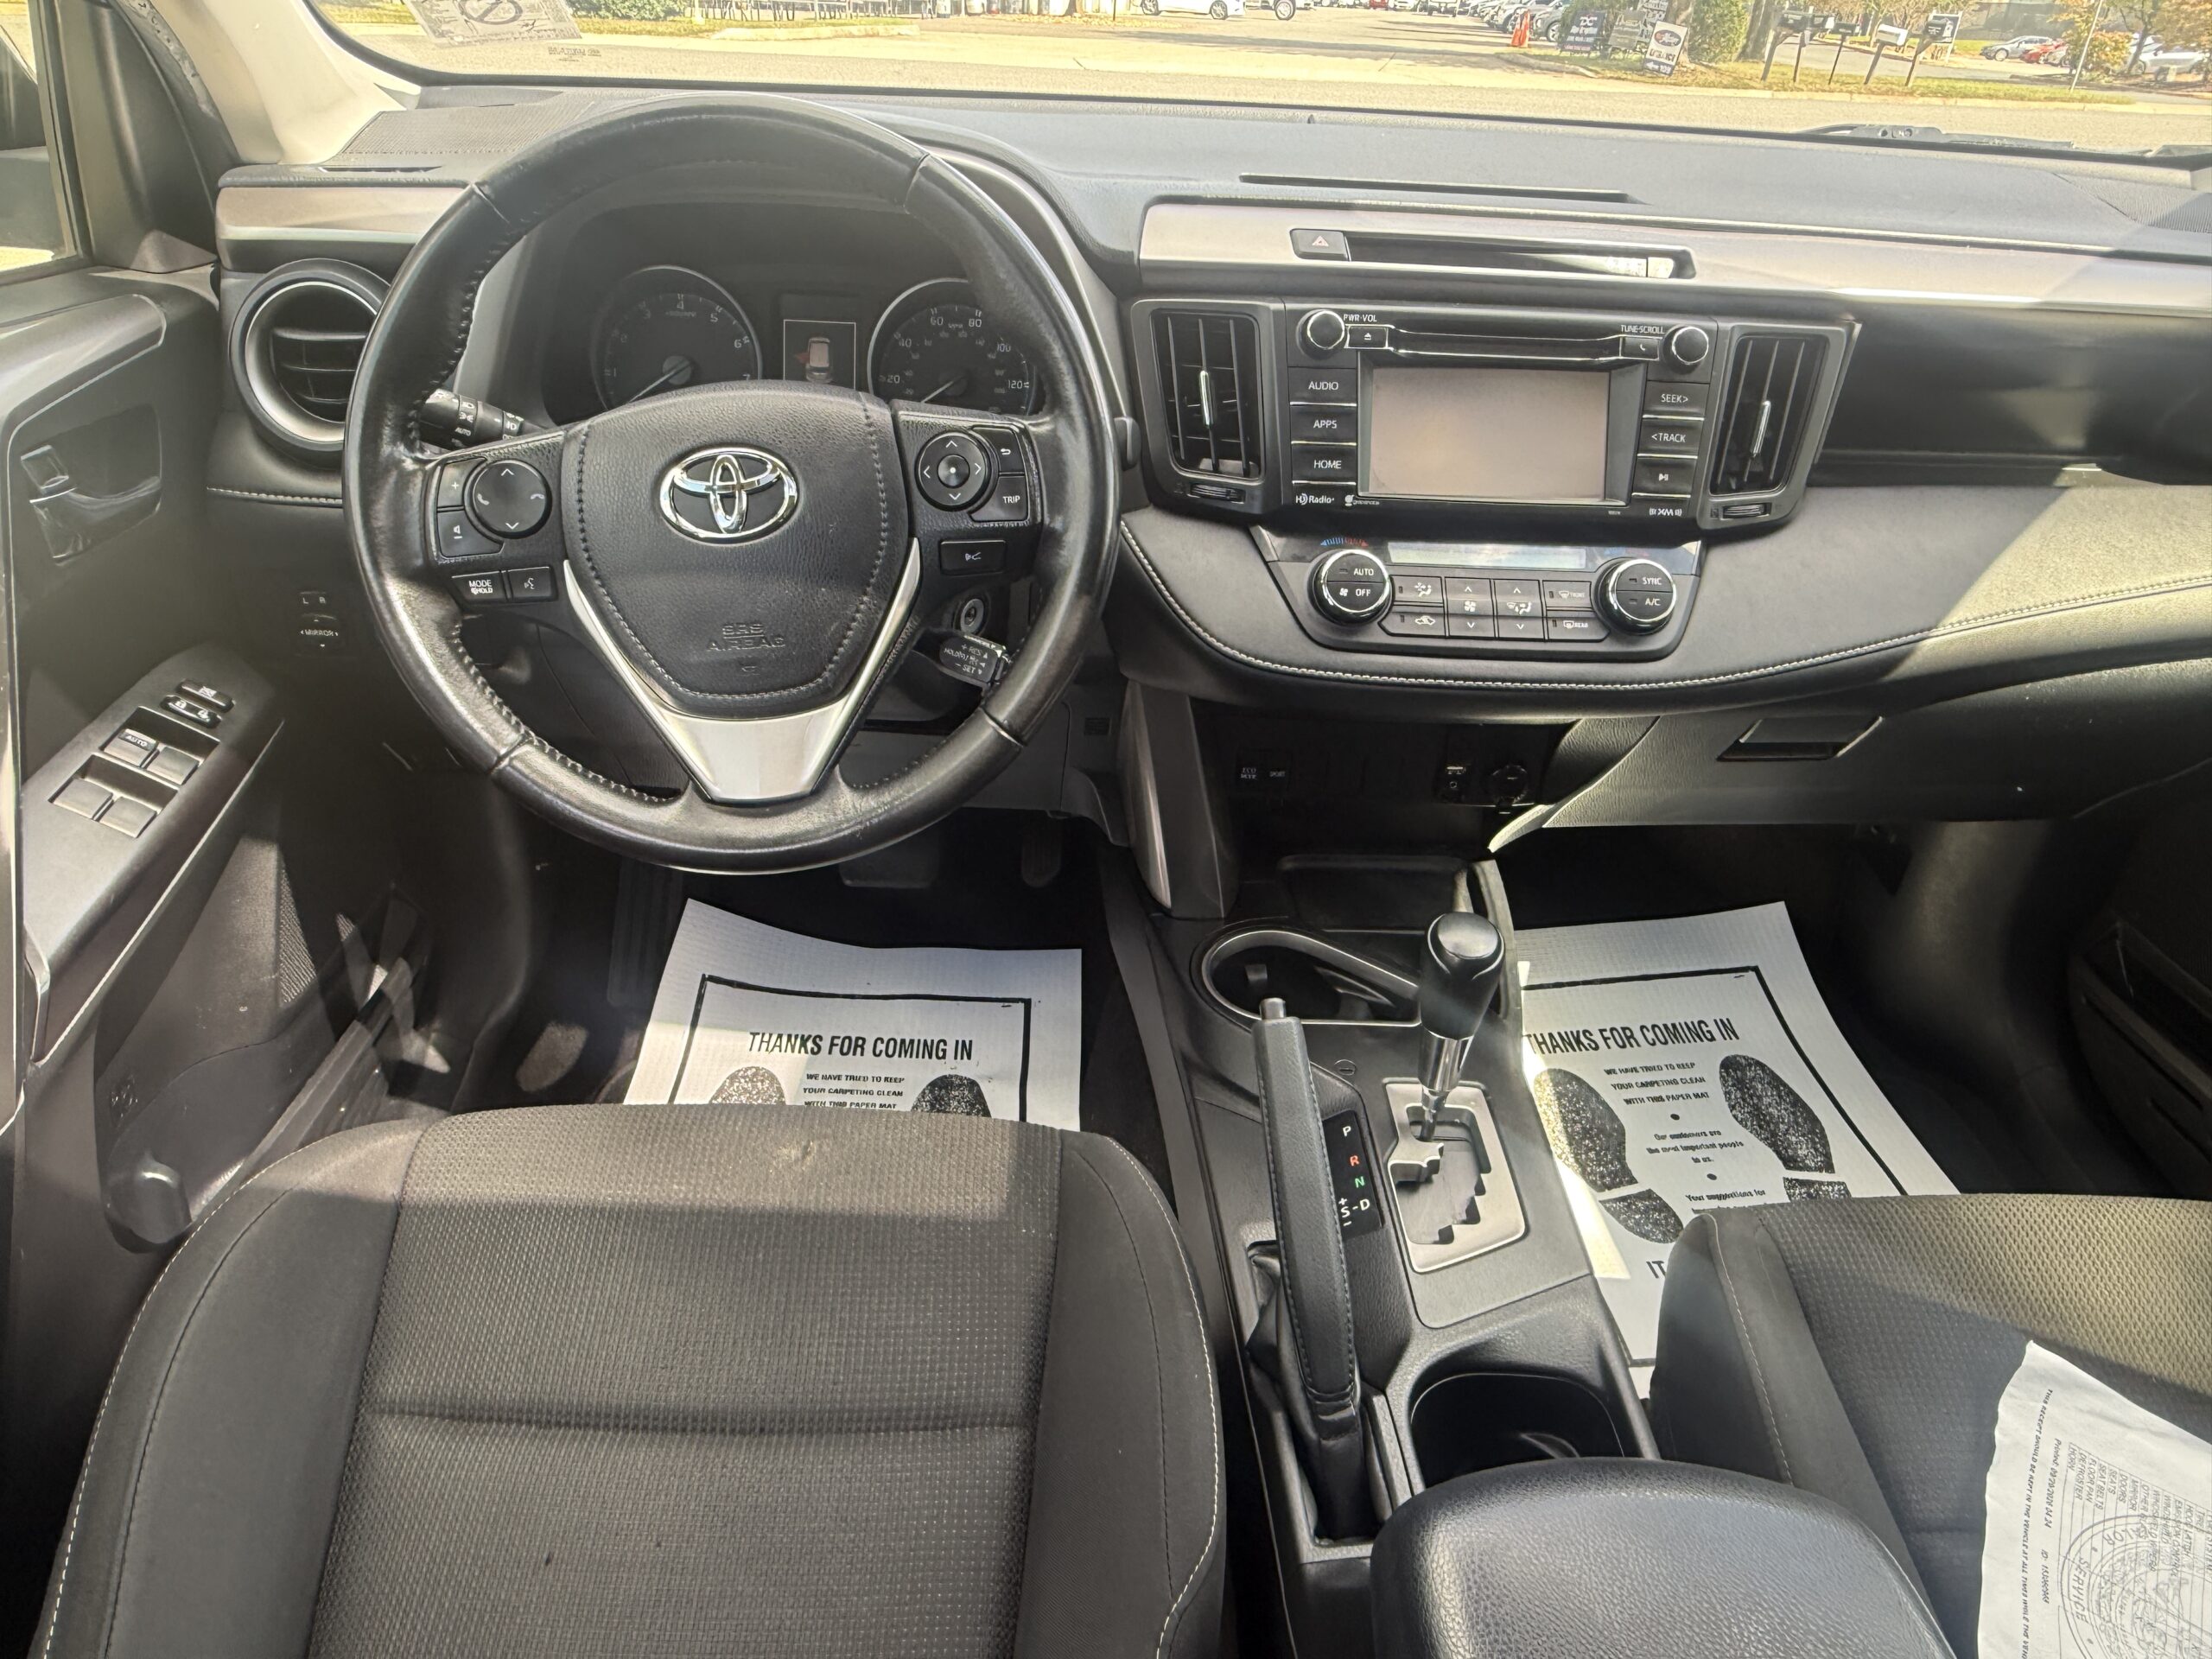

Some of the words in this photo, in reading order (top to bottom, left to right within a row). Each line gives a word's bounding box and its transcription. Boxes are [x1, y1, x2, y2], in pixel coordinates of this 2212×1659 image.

[710, 314, 719, 322] 5
[930, 316, 943, 326] 60
[969, 319, 982, 327] 80
[734, 340, 741, 348] 6
[997, 343, 1011, 353] 100
[887, 375, 900, 385] 20
[1007, 380, 1022, 390] 120
[1308, 381, 1339, 391] AUDIO
[1313, 420, 1338, 429] APPS
[1313, 460, 1342, 469] HOME
[1002, 495, 1020, 504] TRIP
[1308, 494, 1332, 505] Radio
[1353, 568, 1374, 576] AUTO
[1643, 577, 1662, 586] SYNC
[1522, 1029, 1599, 1054] THANKS
[1599, 1027, 1641, 1049] FOR
[1640, 1020, 1717, 1046] COMING
[1713, 1018, 1739, 1040] IN
[748, 1032, 823, 1055] THANKS
[829, 1036, 866, 1057] FOR
[873, 1037, 947, 1060] COMING
[953, 1039, 973, 1060] IN
[1636, 1078, 1680, 1088] CARPETING
[1666, 1093, 1692, 1102] PAPER
[1342, 1126, 1351, 1137] P
[1350, 1155, 1360, 1166] R
[1354, 1176, 1366, 1188] N
[2068, 1447, 2077, 1471] HORN
[2075, 1452, 2088, 1500] DEFROSTER
[2098, 1464, 2107, 1485] SEAT
[2119, 1474, 2128, 1503] DOORS
[2025, 1494, 2032, 1503] IN
[2094, 1484, 2105, 1510] BELTS
[2140, 1485, 2150, 1512] OTHER
